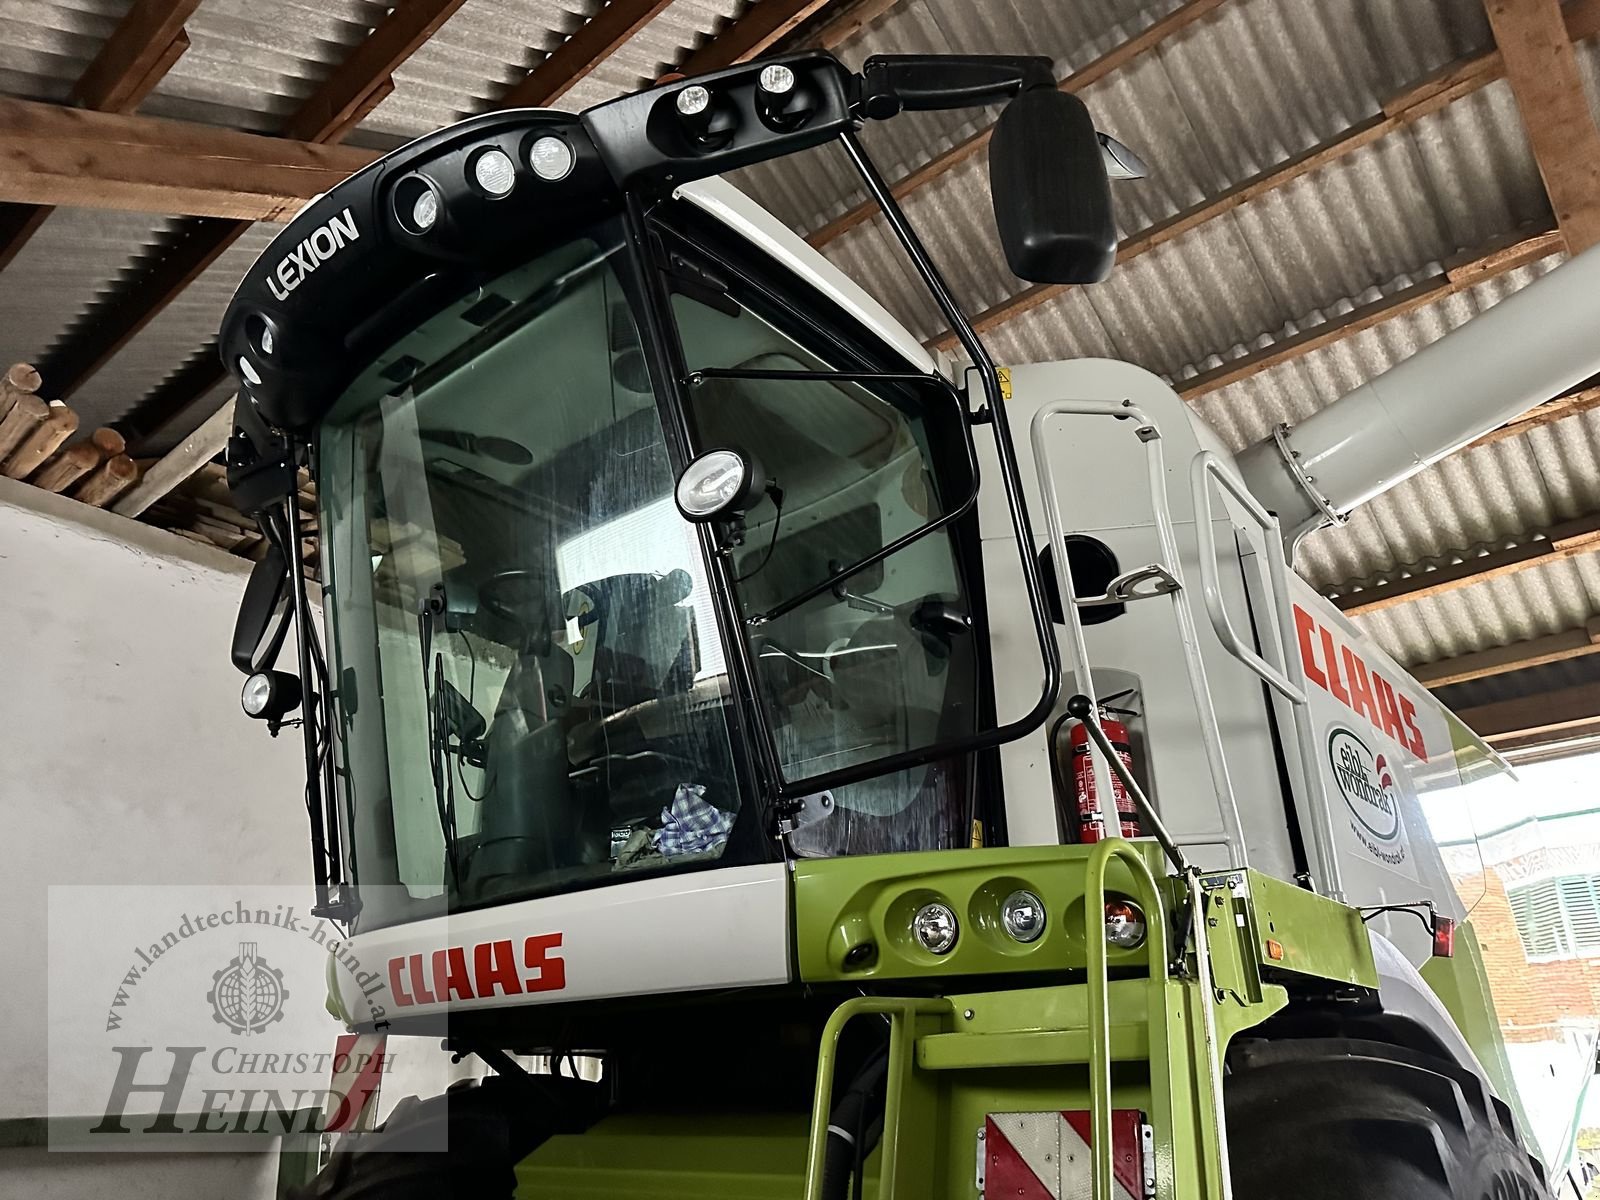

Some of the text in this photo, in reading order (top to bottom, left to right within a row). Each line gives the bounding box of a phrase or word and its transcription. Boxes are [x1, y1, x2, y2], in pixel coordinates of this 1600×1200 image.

[266, 207, 360, 301] LEXION
[1292, 602, 1429, 763] CLAAS
[1336, 765, 1393, 817] wondrak
[388, 932, 566, 1008] CLAAS
